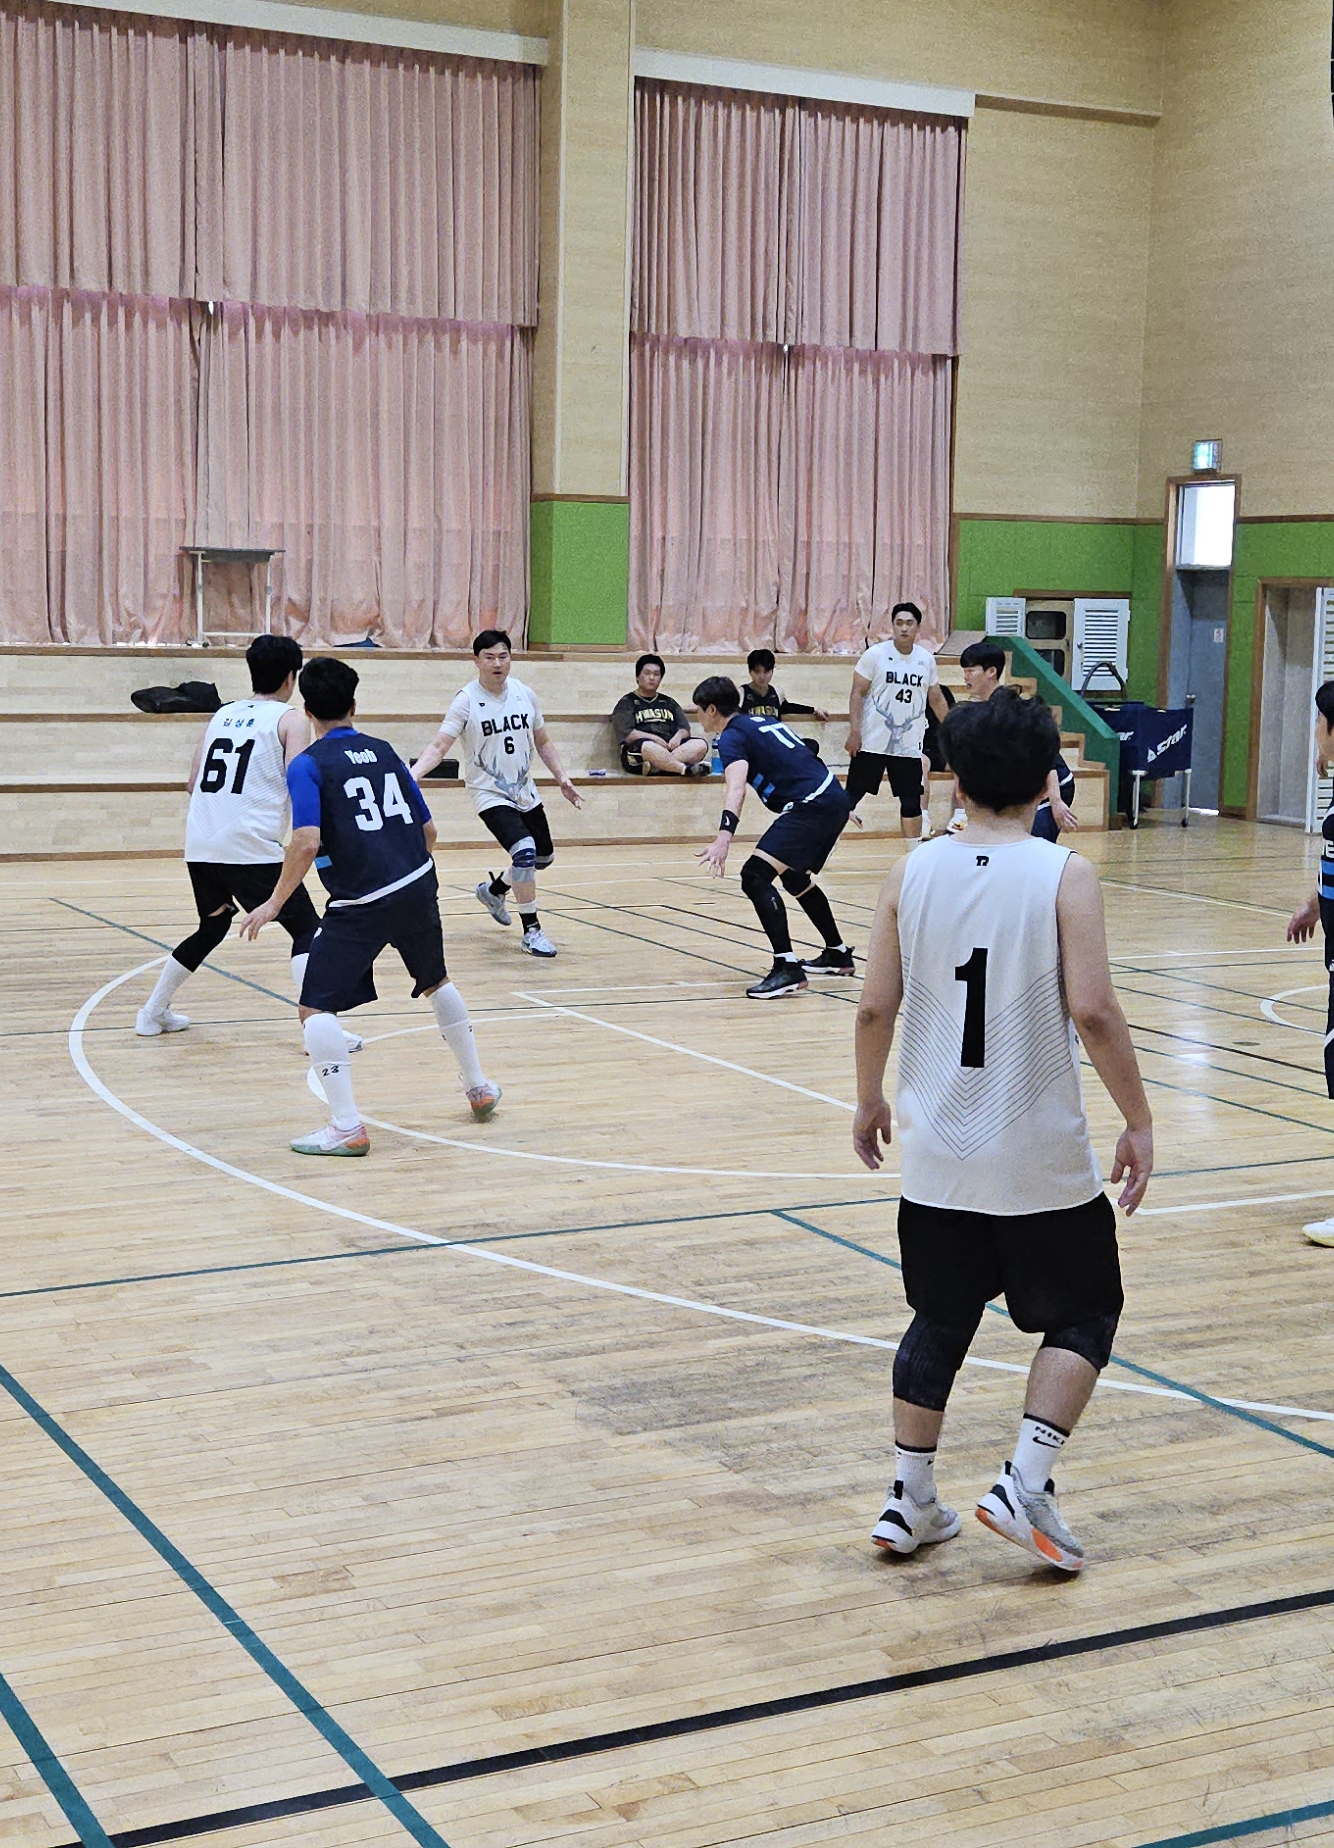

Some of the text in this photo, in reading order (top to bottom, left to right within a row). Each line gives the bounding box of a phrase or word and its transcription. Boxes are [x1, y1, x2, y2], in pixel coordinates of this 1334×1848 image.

[886, 671, 923, 687] BLACK
[895, 688, 913, 703] 43
[481, 713, 529, 737] BLACK
[504, 736, 514, 755] 6
[200, 737, 255, 794] 61
[343, 772, 413, 831] 34
[955, 947, 988, 1068] 1
[322, 1065, 340, 1077] 23
